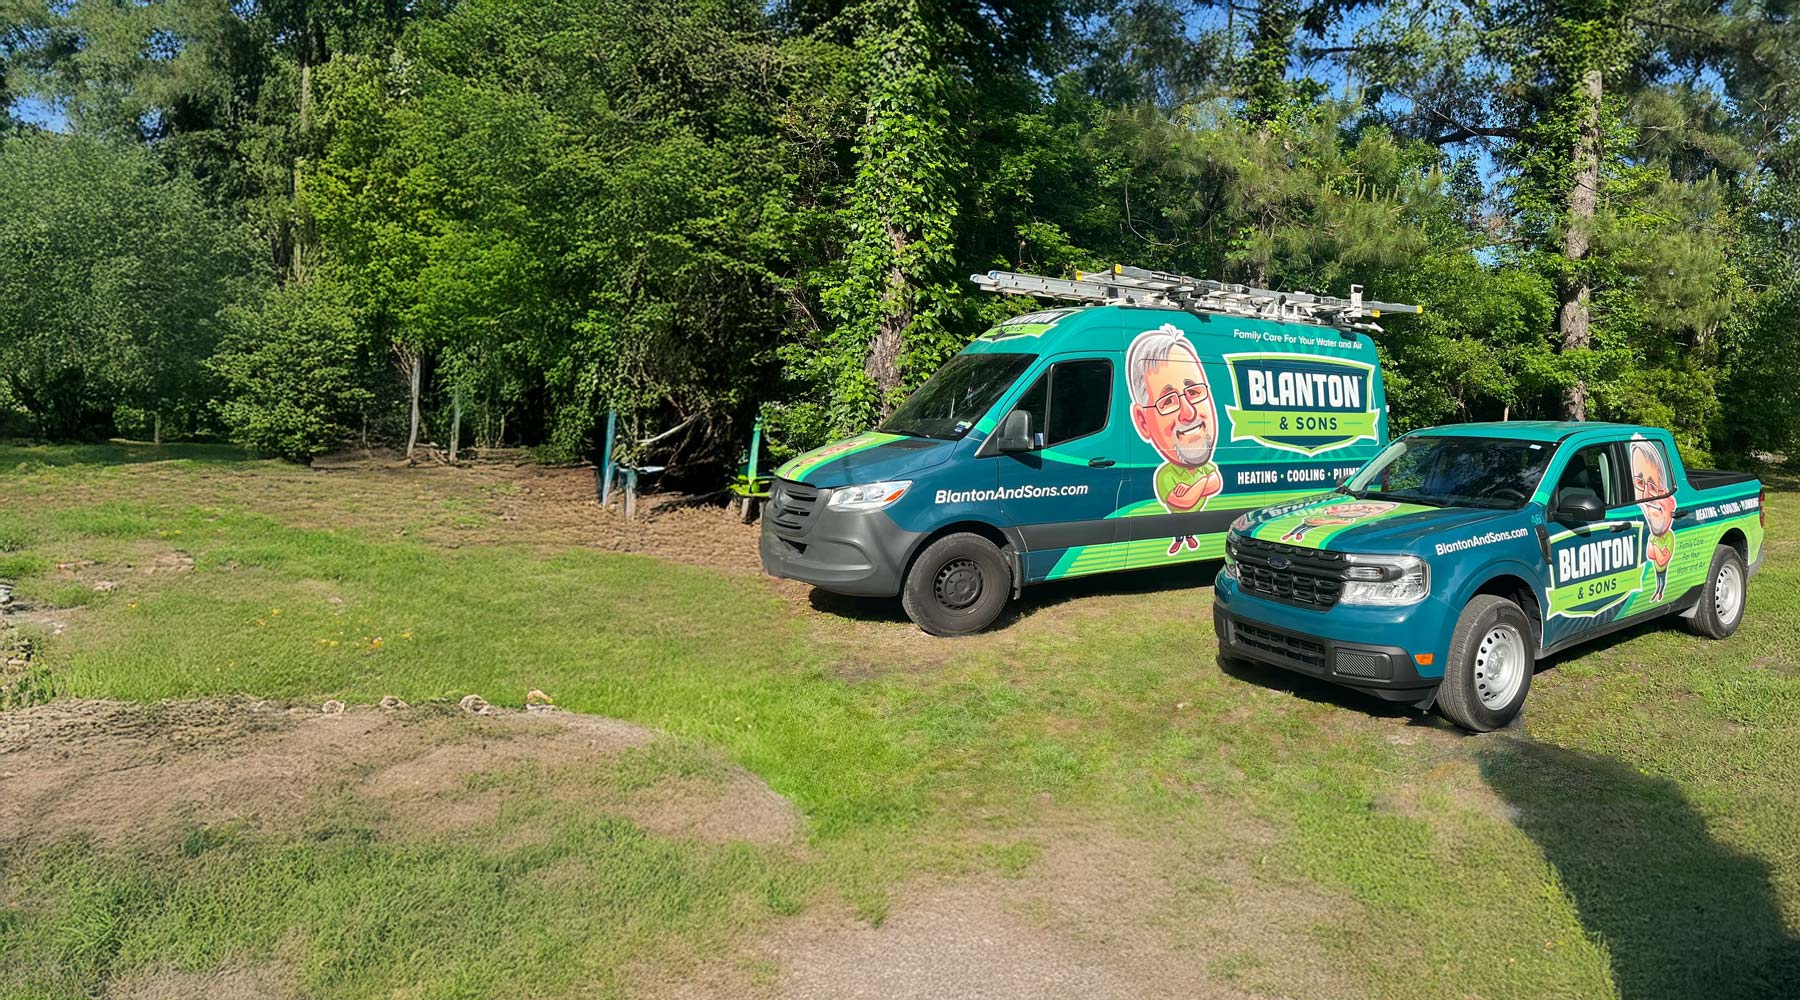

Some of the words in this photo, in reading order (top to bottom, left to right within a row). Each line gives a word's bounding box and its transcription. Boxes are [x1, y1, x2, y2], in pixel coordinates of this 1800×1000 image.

[1233, 329, 1261, 342] Family
[1263, 332, 1282, 342] Care
[1284, 334, 1296, 344] For
[1298, 335, 1315, 346] Your
[1316, 337, 1337, 347] Water
[1338, 340, 1351, 349] and
[1353, 340, 1363, 349] Air
[1247, 369, 1360, 408] BLANTON
[1279, 416, 1288, 430] &
[1296, 417, 1338, 431] SONS
[1237, 470, 1278, 485] HEATING
[1286, 468, 1325, 482] COOLING
[935, 484, 1089, 504] BlantonAndSons.com
[1435, 527, 1528, 556] BlantonAndSons.com
[1558, 535, 1634, 583] BLANTON
[1577, 587, 1584, 600] &
[1588, 578, 1617, 597] SONS
